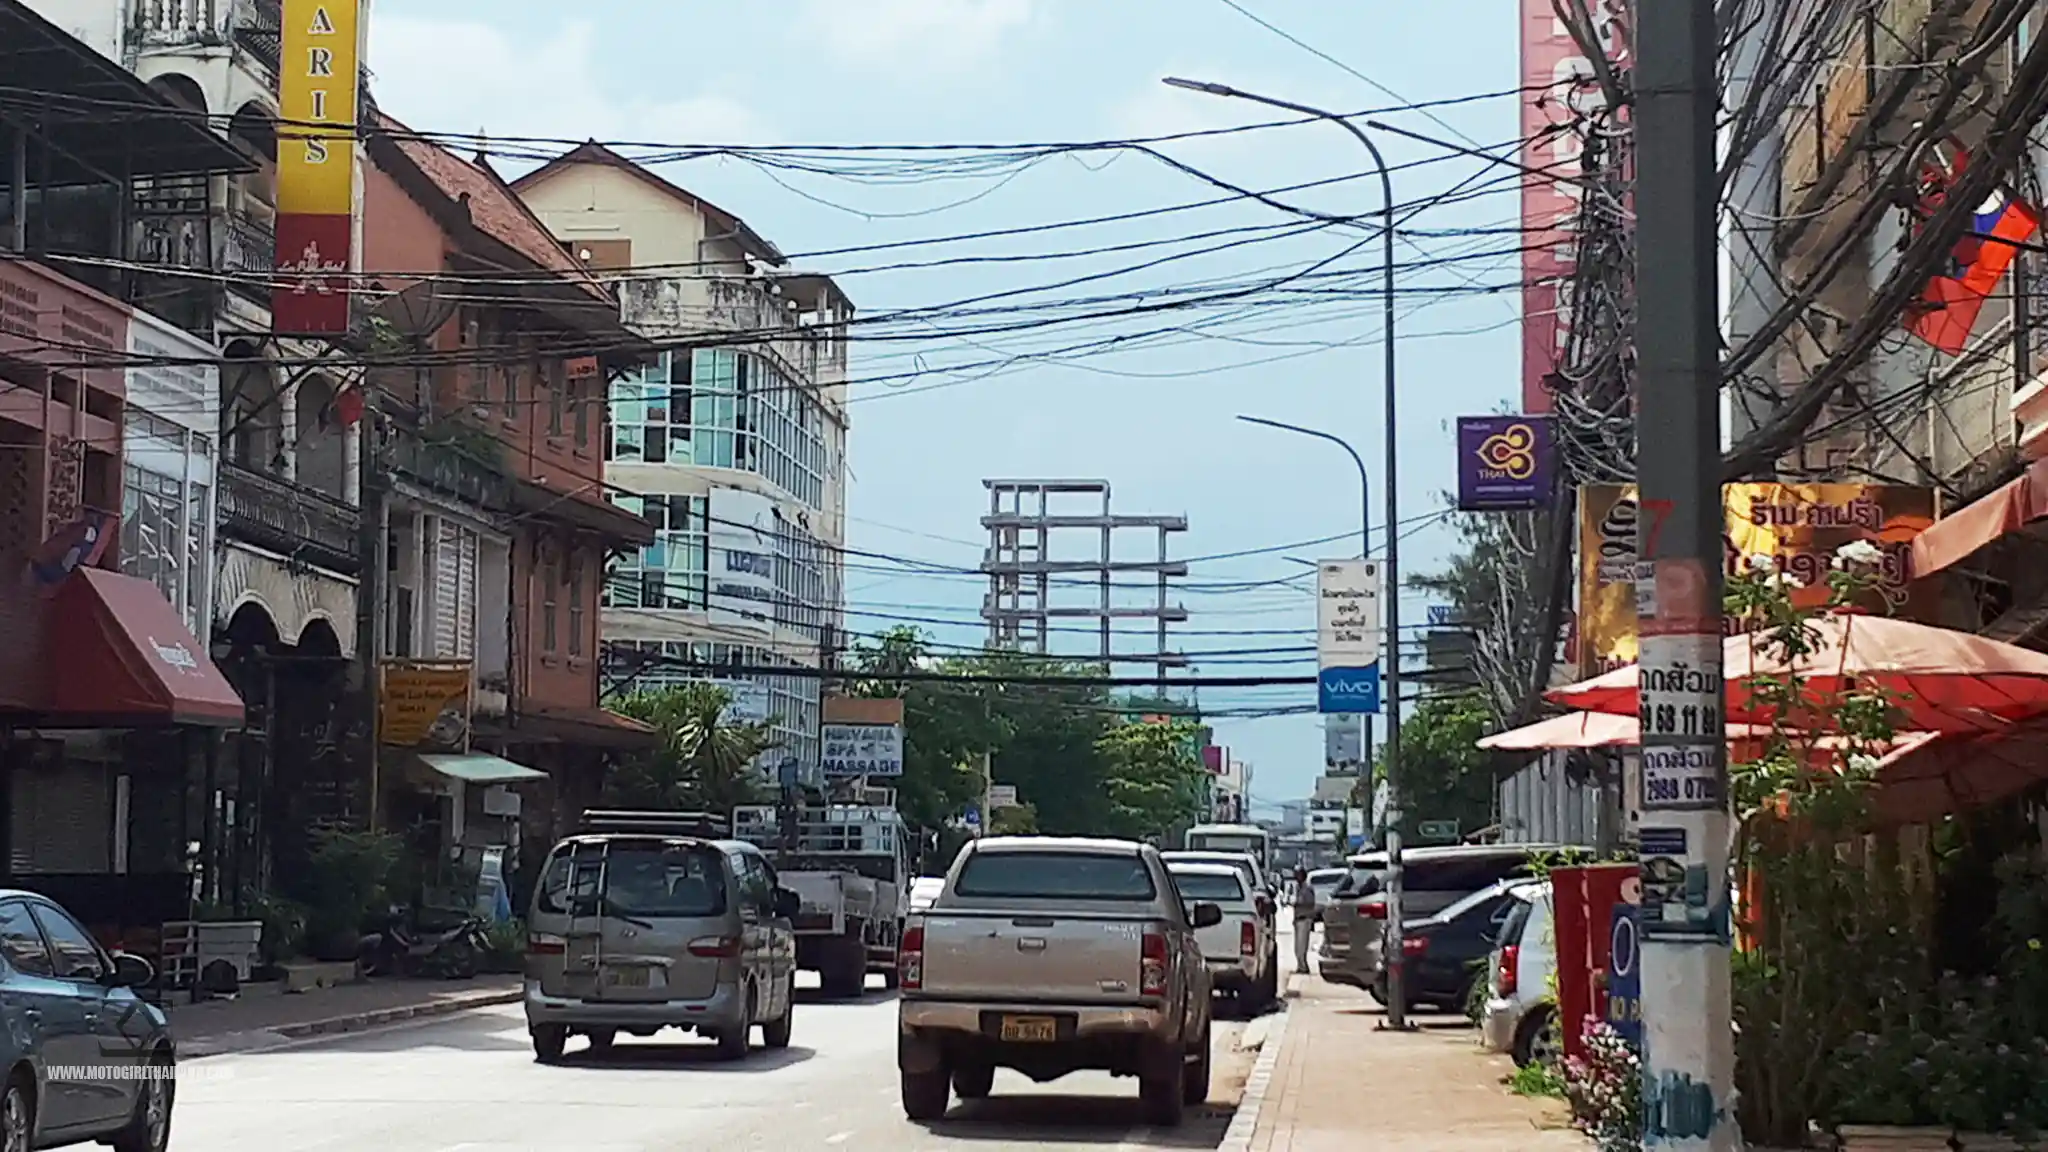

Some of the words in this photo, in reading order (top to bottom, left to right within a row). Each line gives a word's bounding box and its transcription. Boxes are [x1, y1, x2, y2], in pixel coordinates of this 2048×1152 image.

[1477, 468, 1507, 481] THAI
[1325, 678, 1373, 694] vivo
[823, 758, 901, 773] MASSAGE
